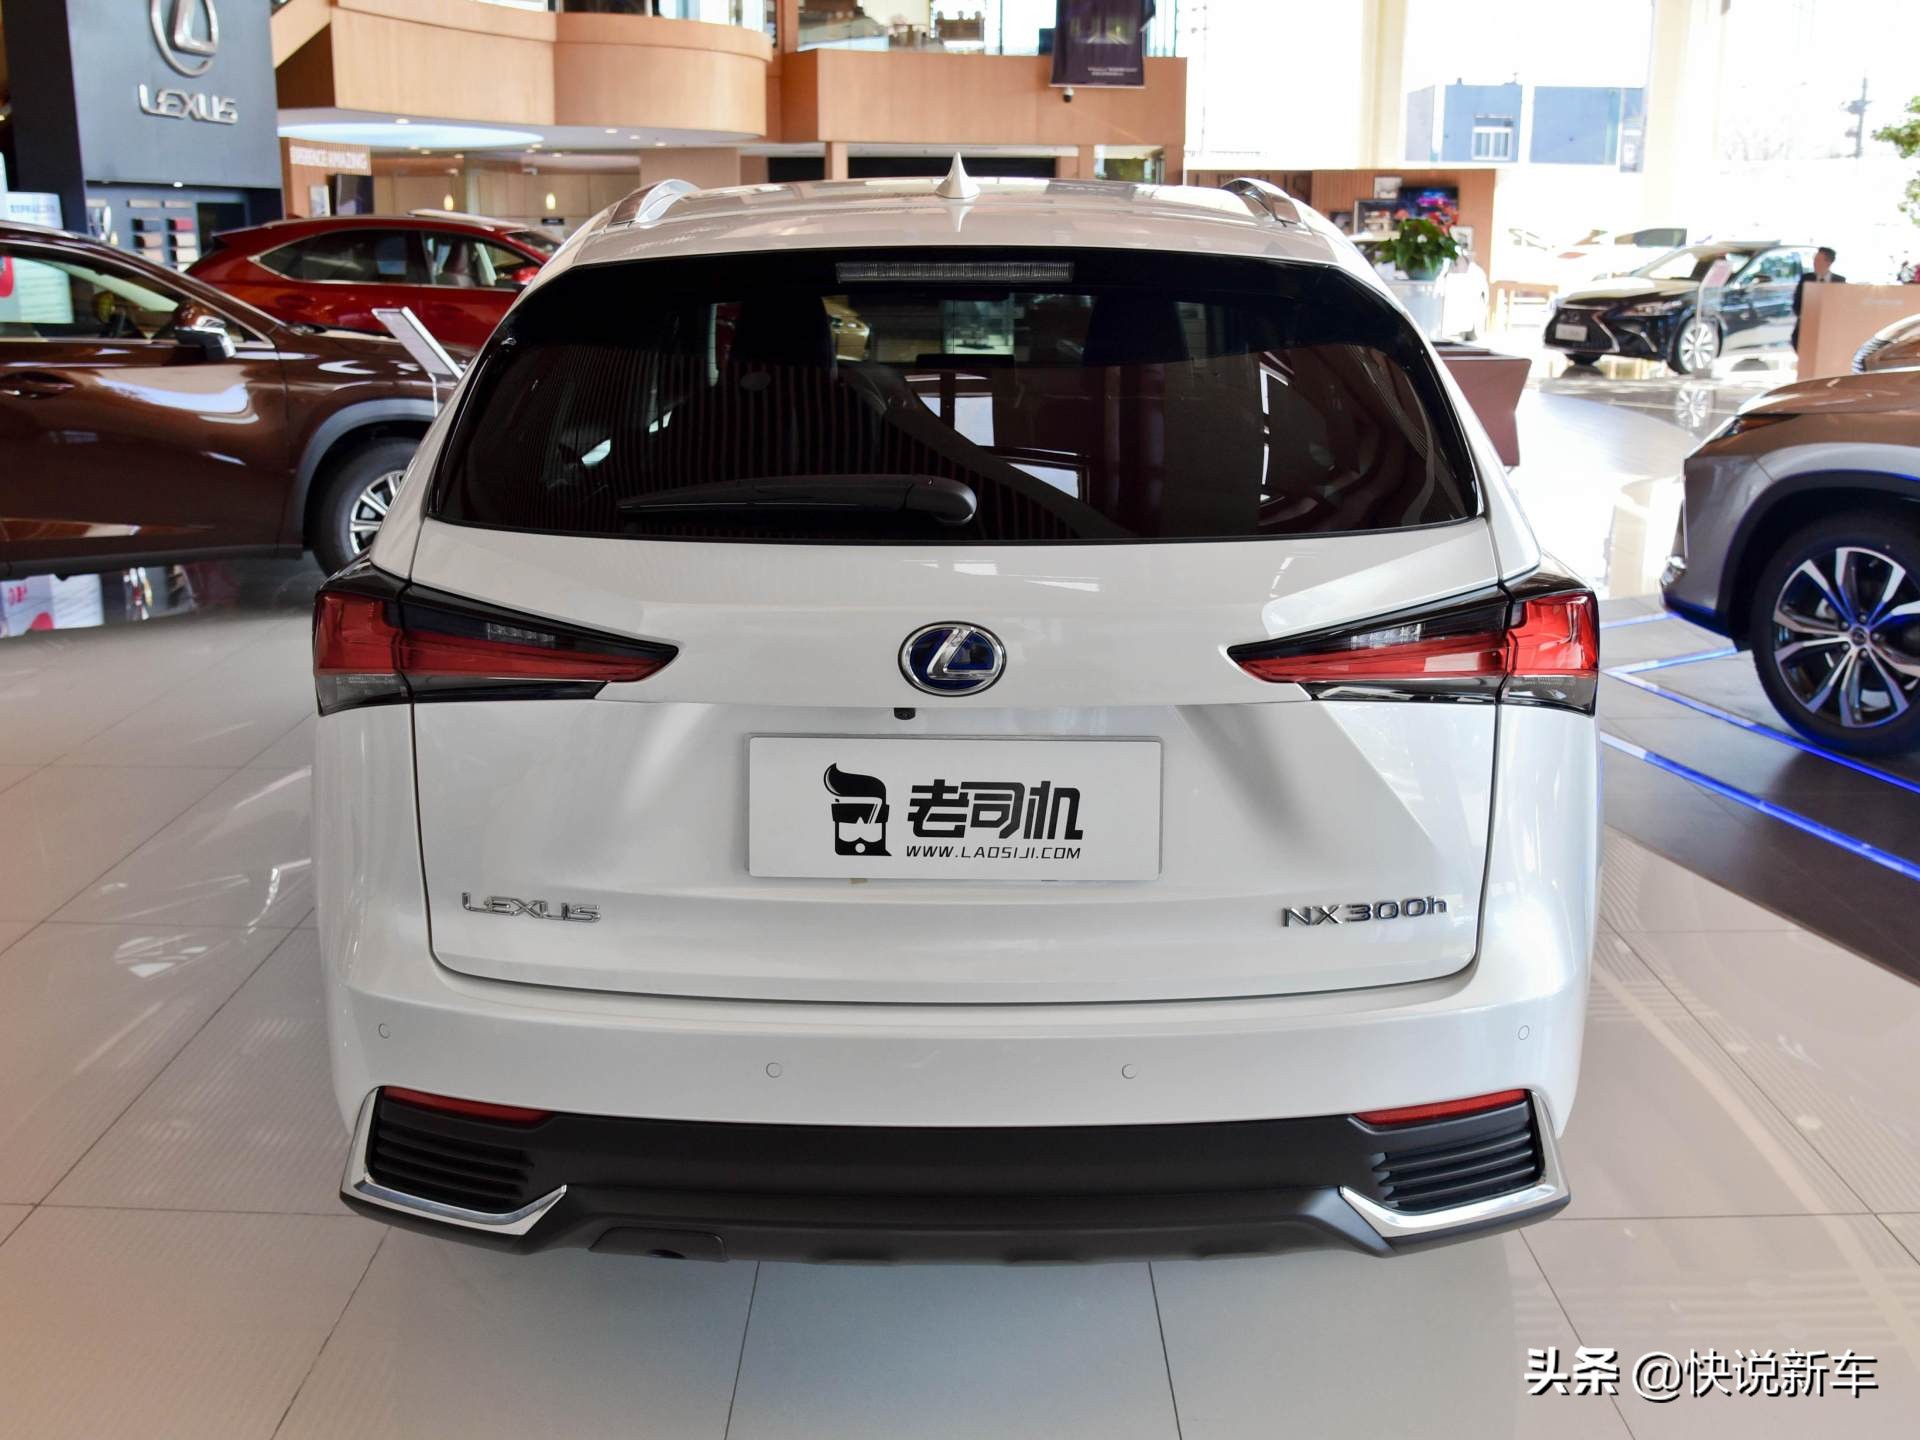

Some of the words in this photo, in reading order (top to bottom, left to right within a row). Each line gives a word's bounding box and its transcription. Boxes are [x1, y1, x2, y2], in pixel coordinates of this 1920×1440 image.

[139, 83, 239, 125] LEXUS
[907, 779, 1083, 841] 老司机
[906, 845, 1081, 860] WWW.LAOSIJI.COM
[461, 892, 601, 923] LEXUS
[1281, 896, 1448, 928] NX300h
